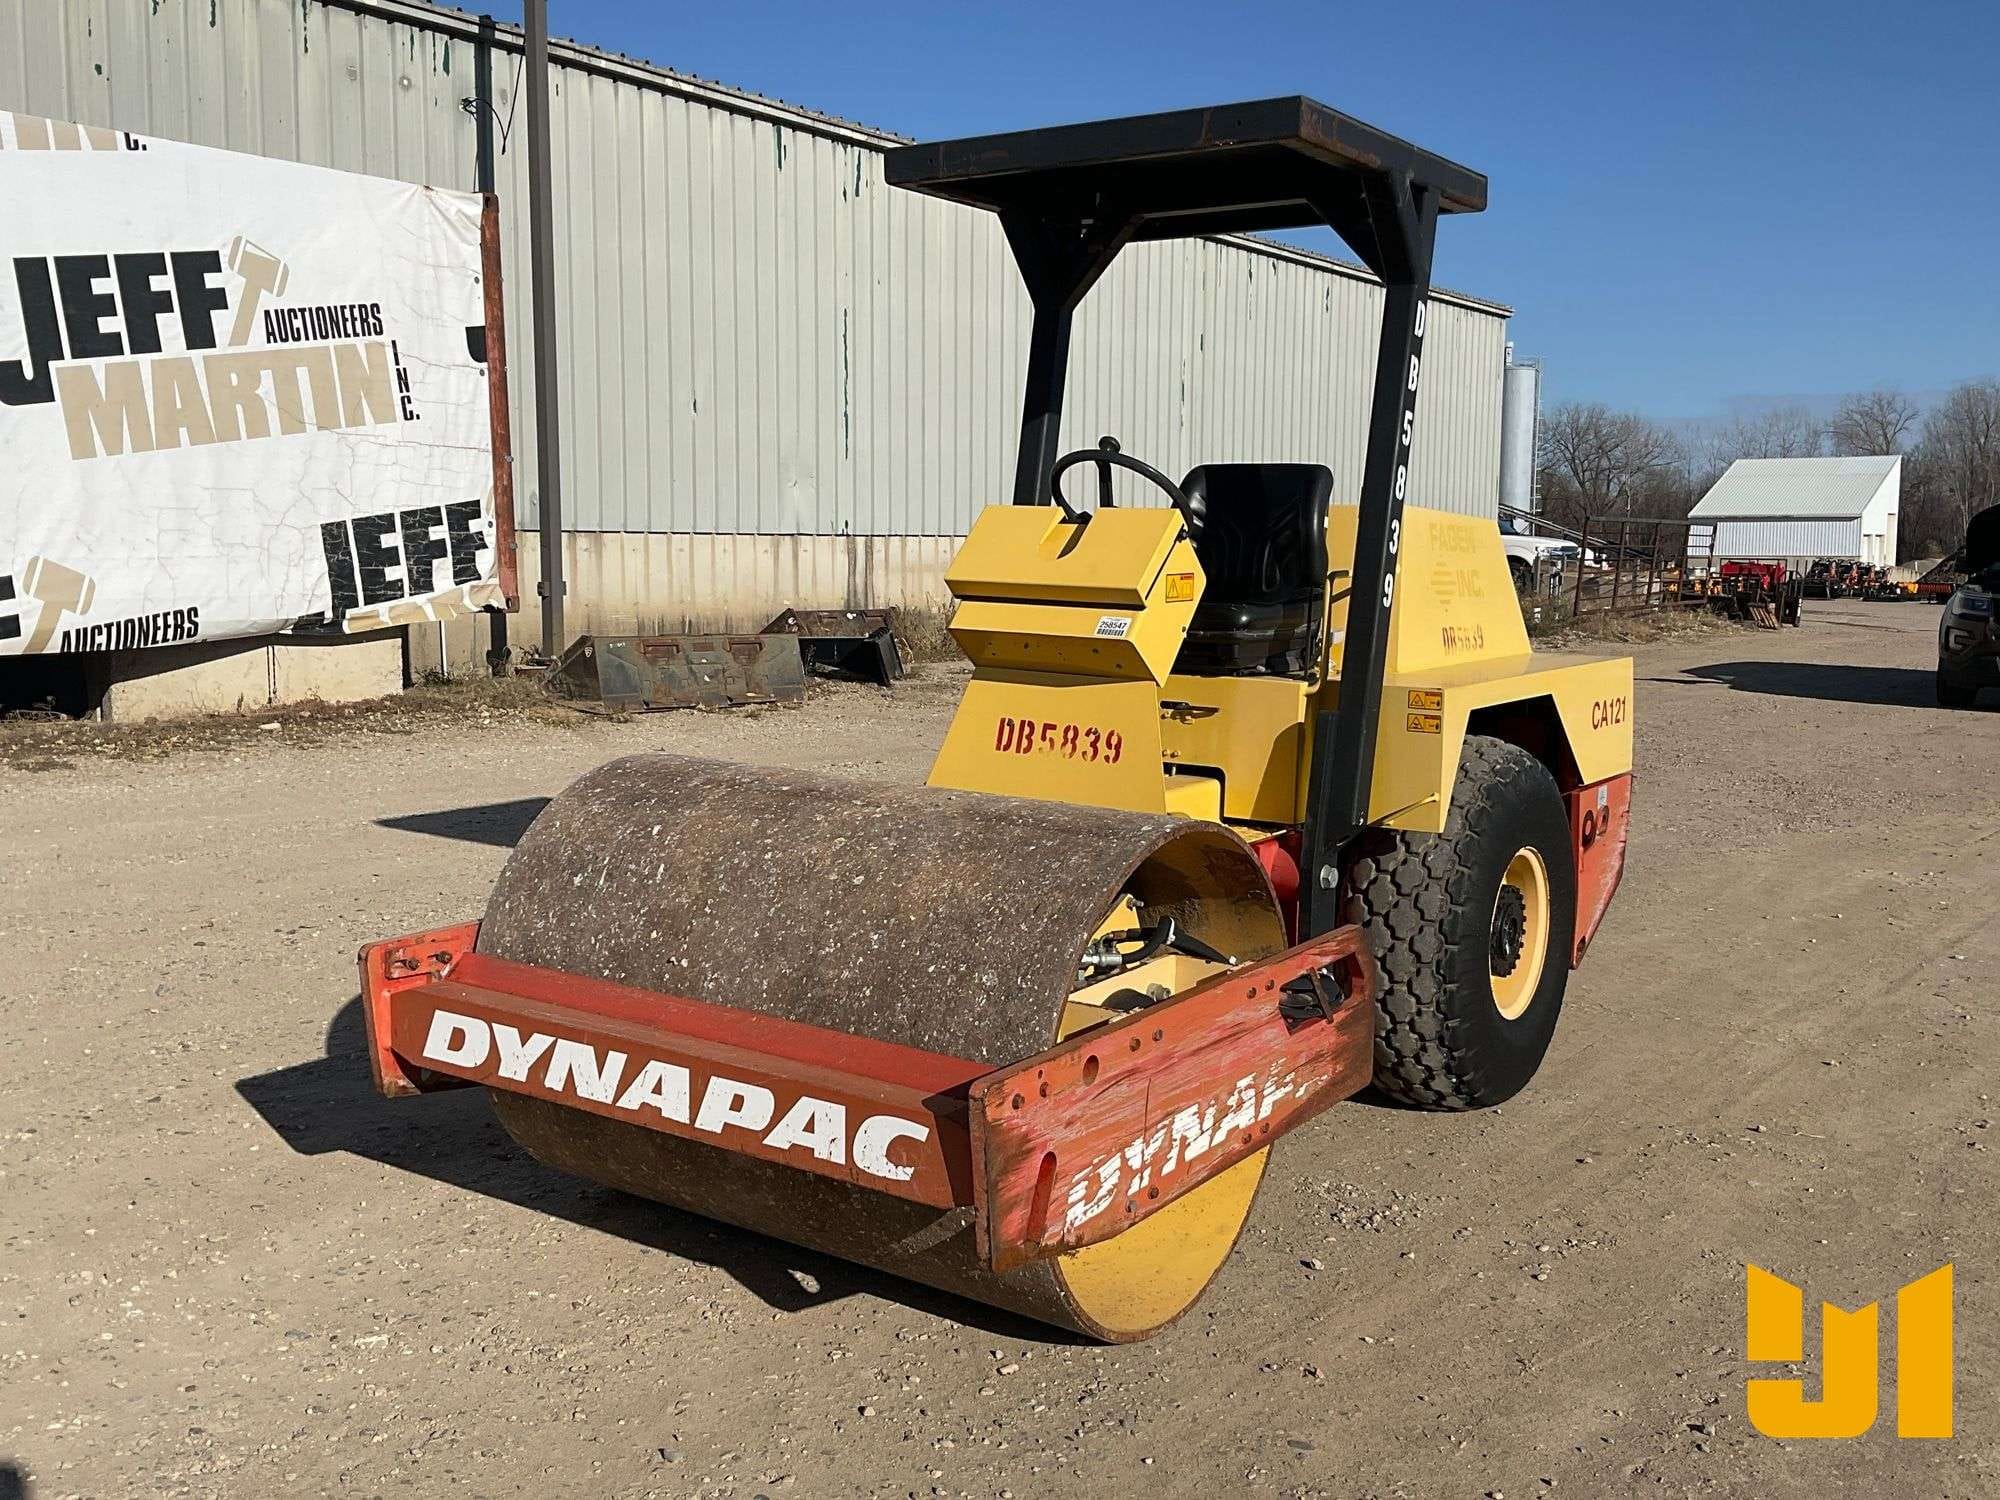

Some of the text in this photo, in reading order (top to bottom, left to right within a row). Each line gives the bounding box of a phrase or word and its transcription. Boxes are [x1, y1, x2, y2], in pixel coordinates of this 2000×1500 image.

[0, 250, 228, 405] JEFF
[264, 303, 384, 344] AUCTIONEERS
[56, 342, 397, 461] MARTIN
[391, 340, 420, 421] INC.
[1382, 300, 1427, 608] DB5839
[291, 499, 489, 634] JEFF
[60, 606, 199, 653] AUCTIONEERS
[995, 717, 1123, 764] DB5839
[1592, 696, 1627, 730] CA121
[422, 1009, 930, 1181] DYNAPAC
